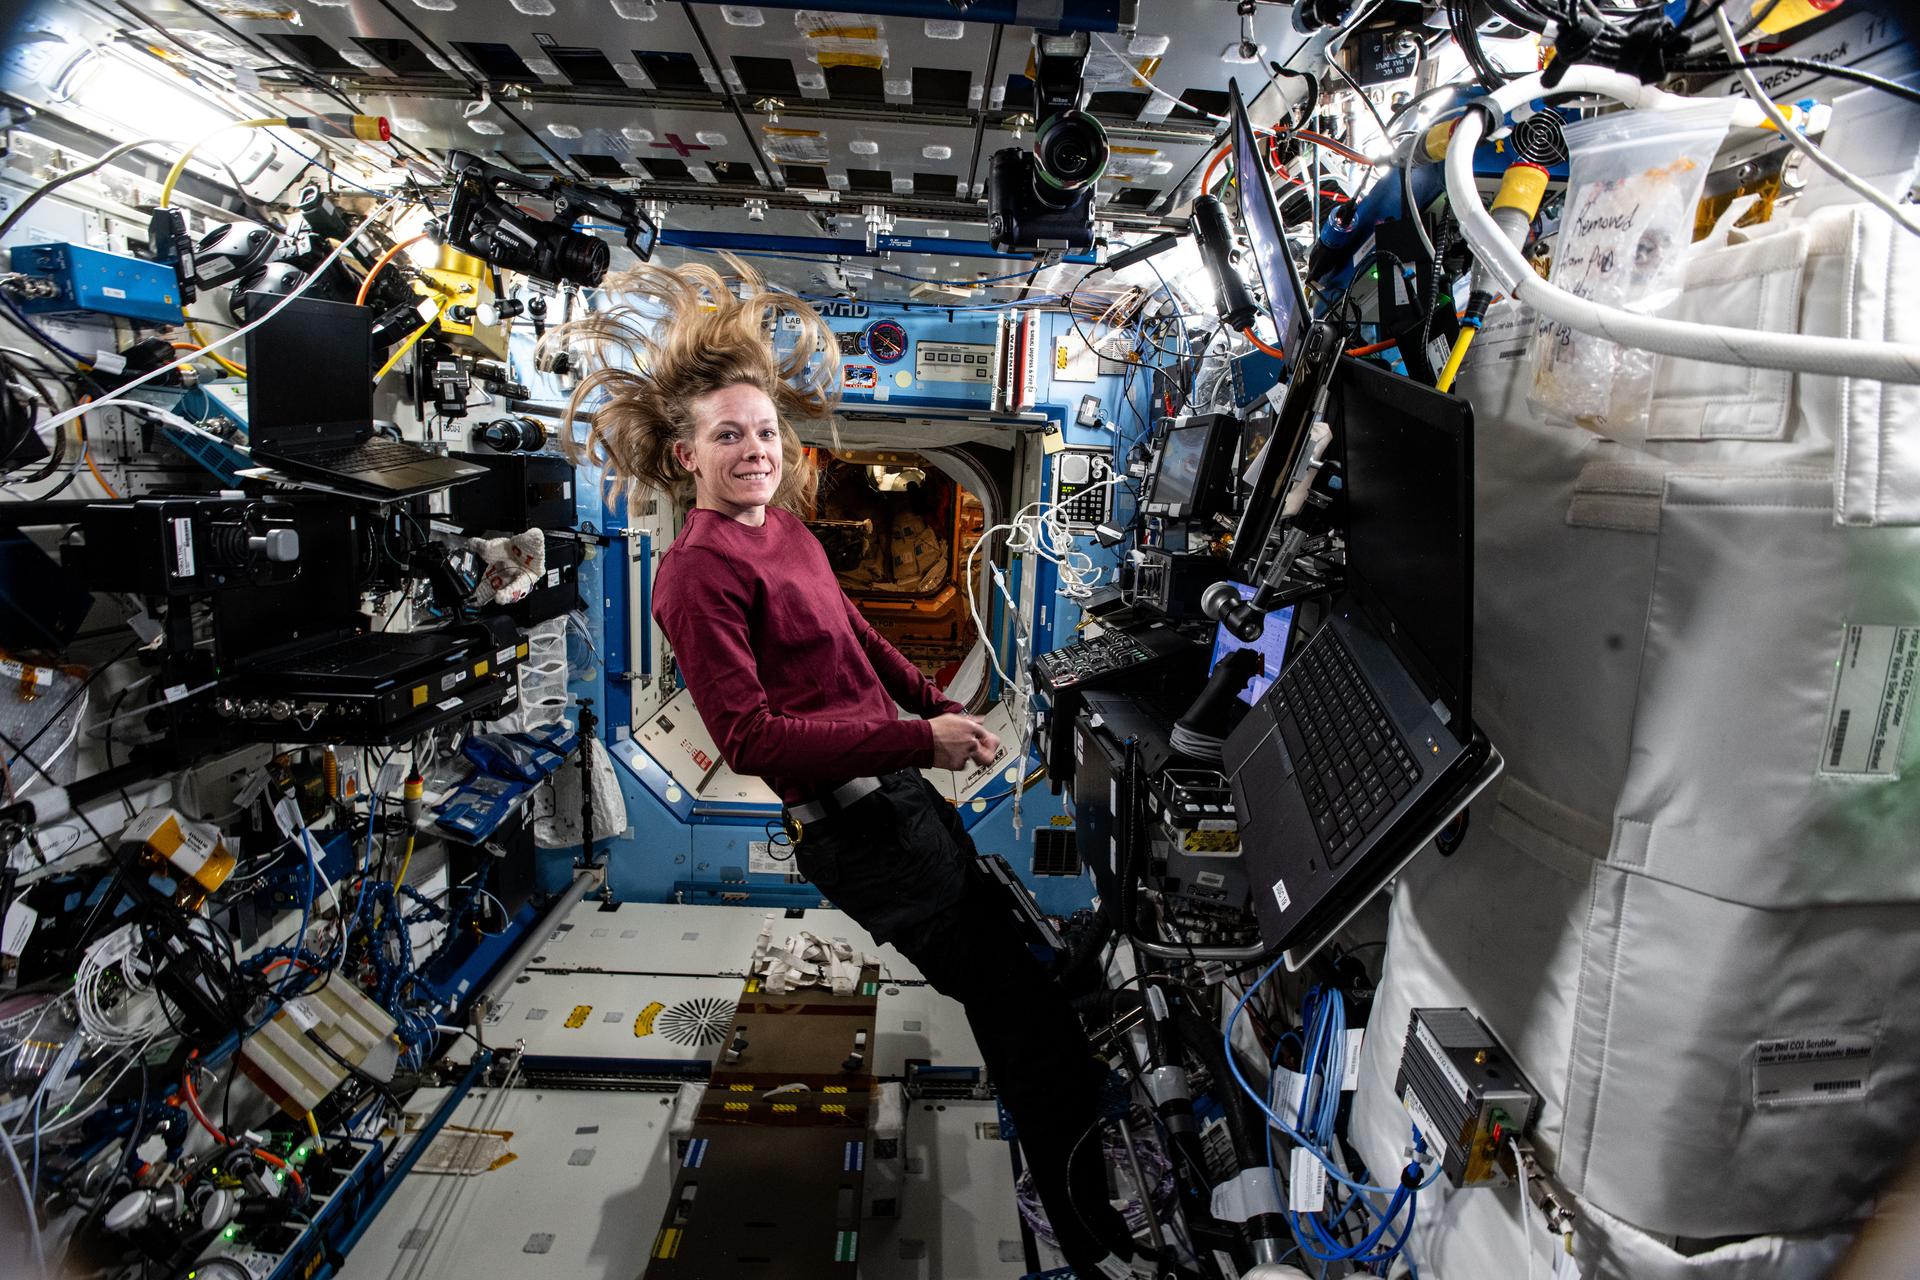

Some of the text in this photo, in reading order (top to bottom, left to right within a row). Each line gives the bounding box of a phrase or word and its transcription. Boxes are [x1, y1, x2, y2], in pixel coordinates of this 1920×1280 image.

[1729, 66, 1803, 97] ERESS
[1573, 203, 1639, 238] Removed
[495, 230, 519, 247] Canon
[1008, 334, 1016, 387] WARNING
[1896, 628, 1909, 654] Lower
[1890, 656, 1903, 679] Valve
[1886, 681, 1898, 699] Side
[1878, 701, 1893, 737] Acoustic
[1758, 1054, 1776, 1062] ower
[1777, 1052, 1796, 1062] Valve
[1814, 1049, 1844, 1058] Acoustic
[1846, 1047, 1871, 1056] Blanket
[1790, 1041, 1804, 1051] CO2
[1806, 1039, 1837, 1049] Scrubber
